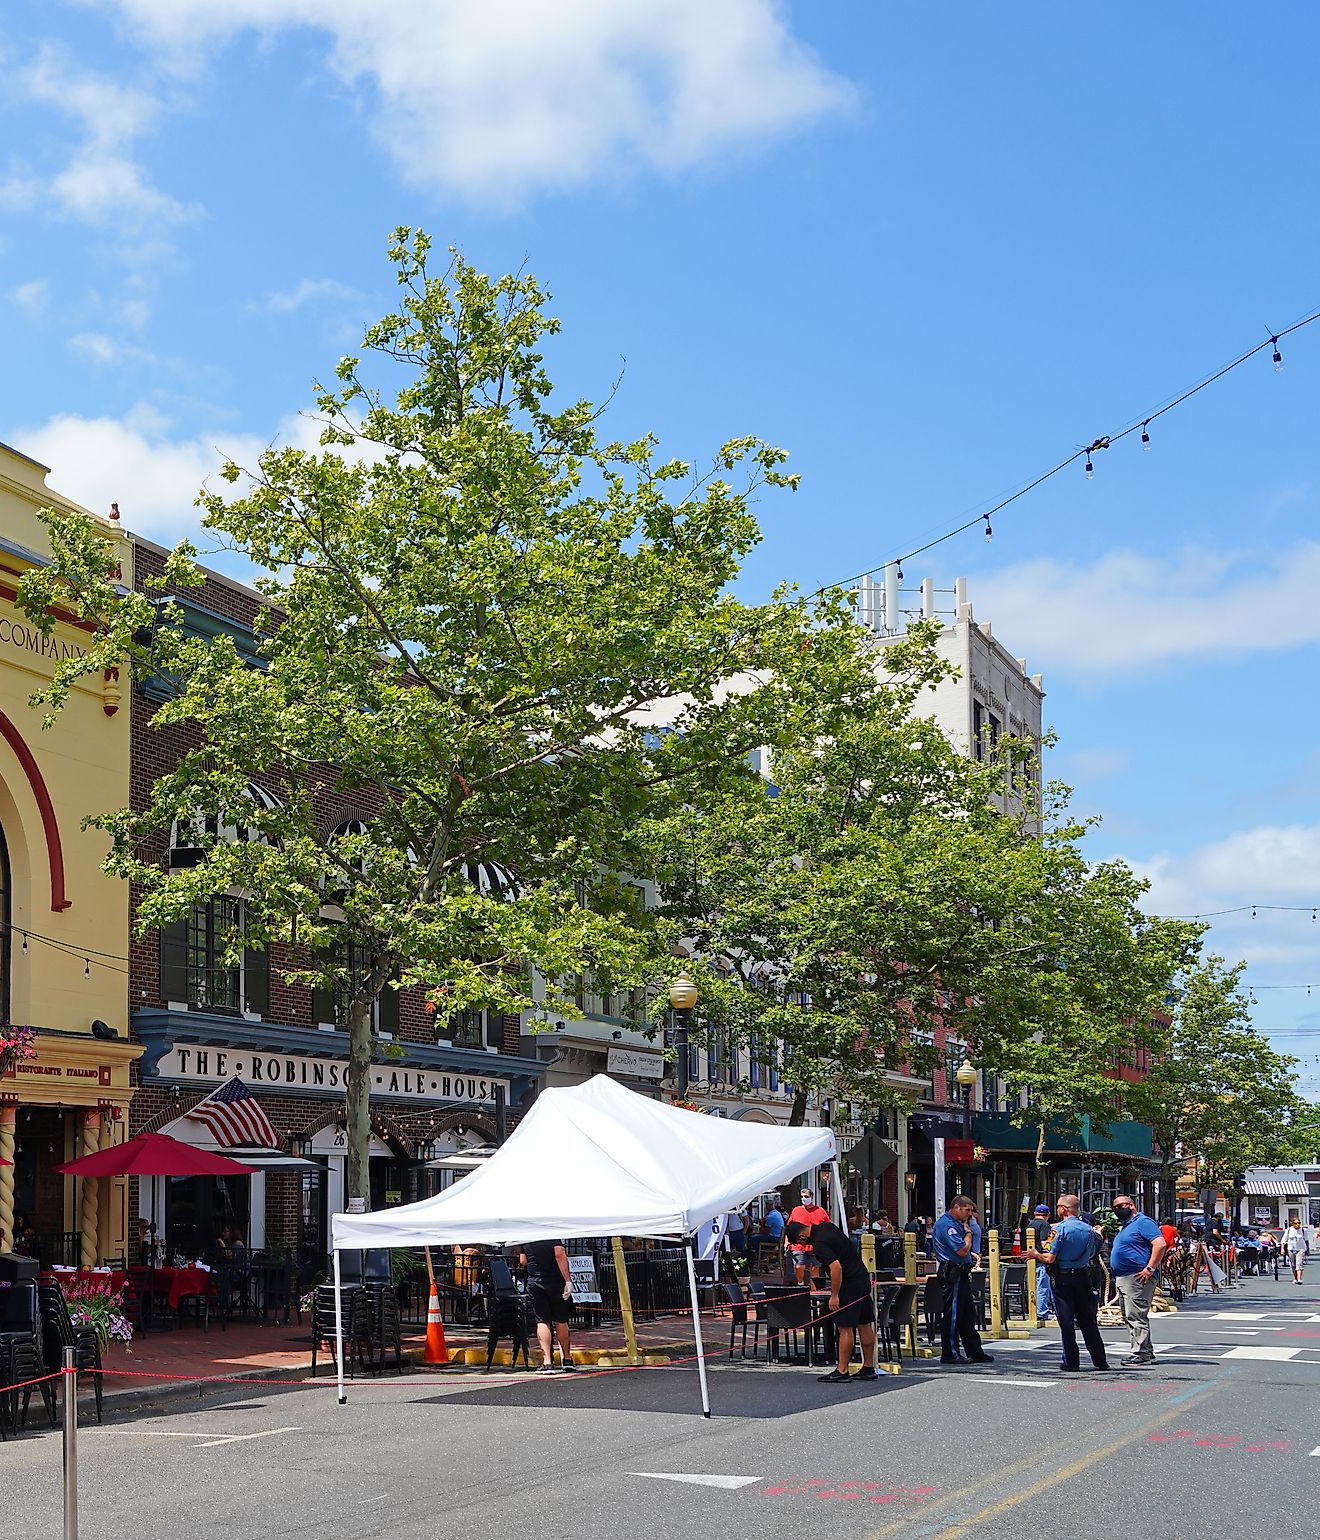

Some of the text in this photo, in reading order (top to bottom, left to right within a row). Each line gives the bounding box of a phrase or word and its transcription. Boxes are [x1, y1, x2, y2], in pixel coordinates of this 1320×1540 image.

[16, 1064, 98, 1078] RISTORANTE ITALIANO
[177, 1048, 498, 1100] THE ROBINSO ALE HOUSE
[333, 1132, 345, 1147] 26
